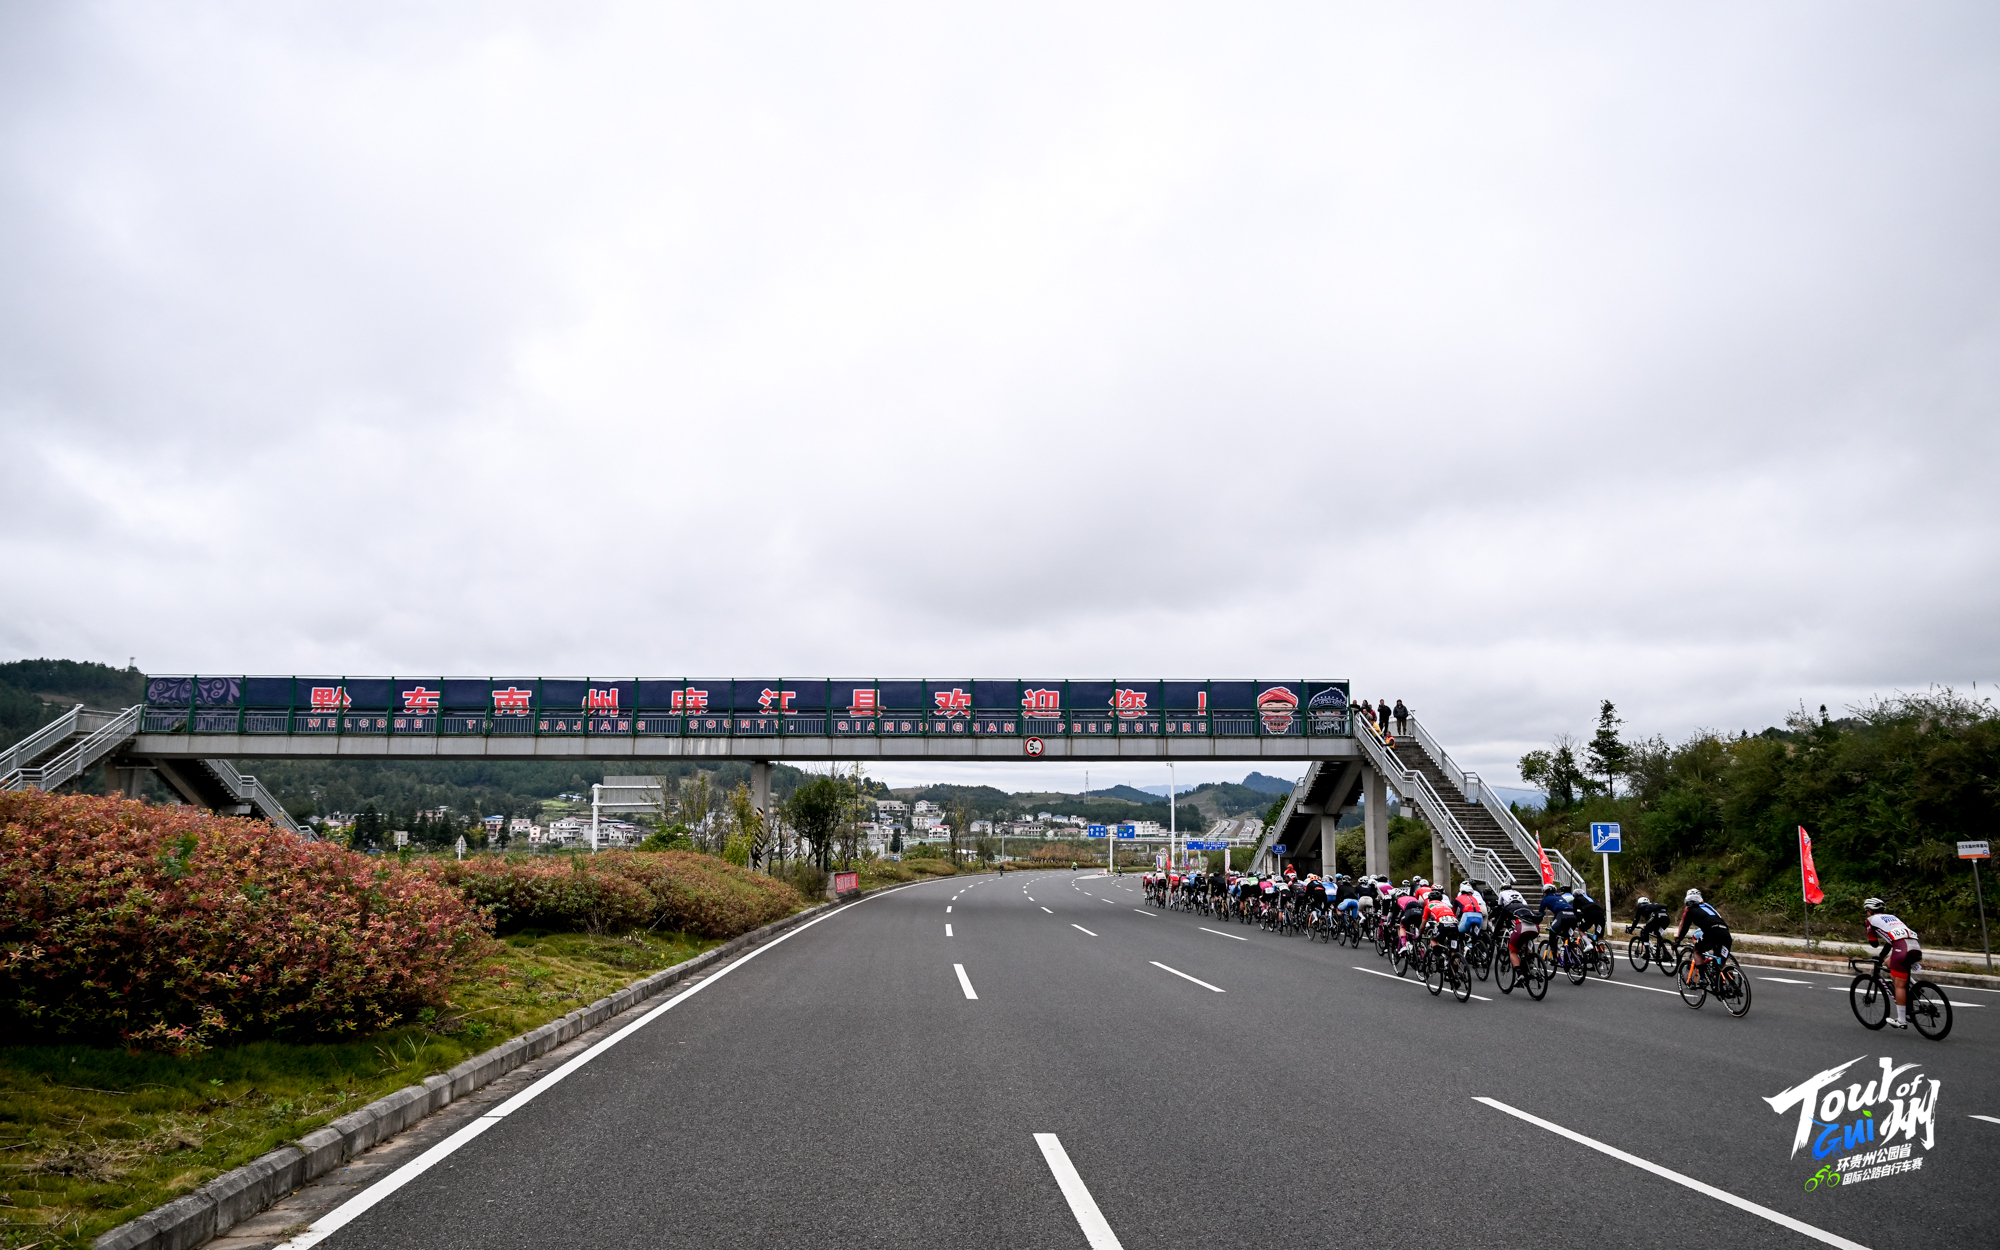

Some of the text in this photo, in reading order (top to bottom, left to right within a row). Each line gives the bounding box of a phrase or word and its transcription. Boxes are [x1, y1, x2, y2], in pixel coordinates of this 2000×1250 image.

[307, 719, 422, 728] WELCOME
[538, 721, 647, 730] MAJIANG
[837, 722, 1014, 732] QIANDONGNAN
[1057, 723, 1206, 732] PREFECTURE
